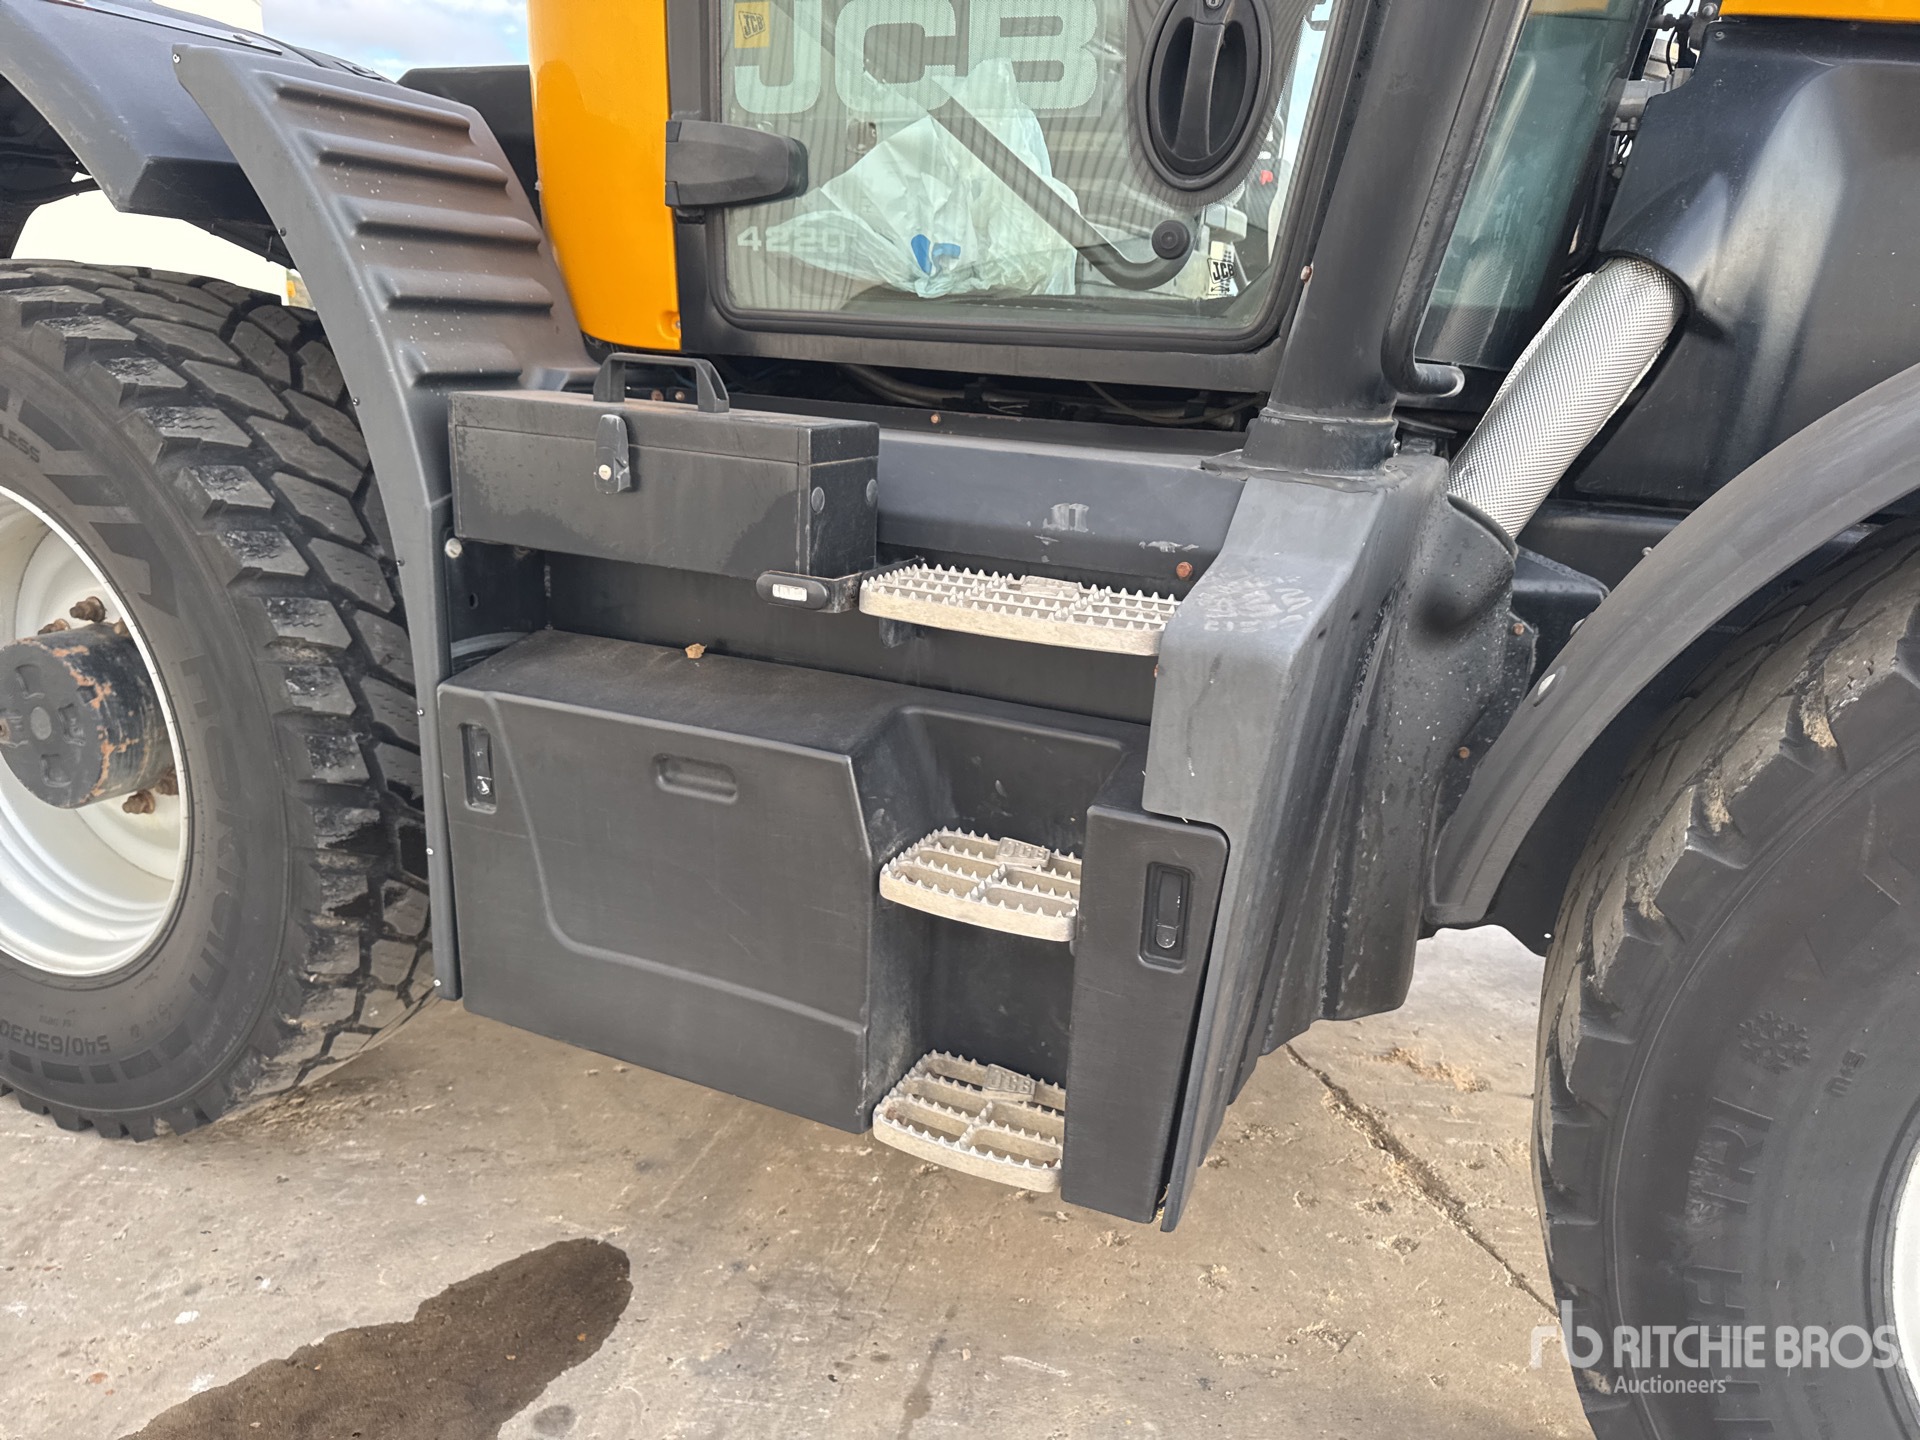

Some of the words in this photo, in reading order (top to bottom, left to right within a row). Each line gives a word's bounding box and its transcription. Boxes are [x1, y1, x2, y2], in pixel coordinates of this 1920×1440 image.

[742, 13, 766, 36] JCB
[735, 0, 1098, 114] JCB
[737, 225, 846, 253] 4220
[1212, 261, 1235, 281] JCB
